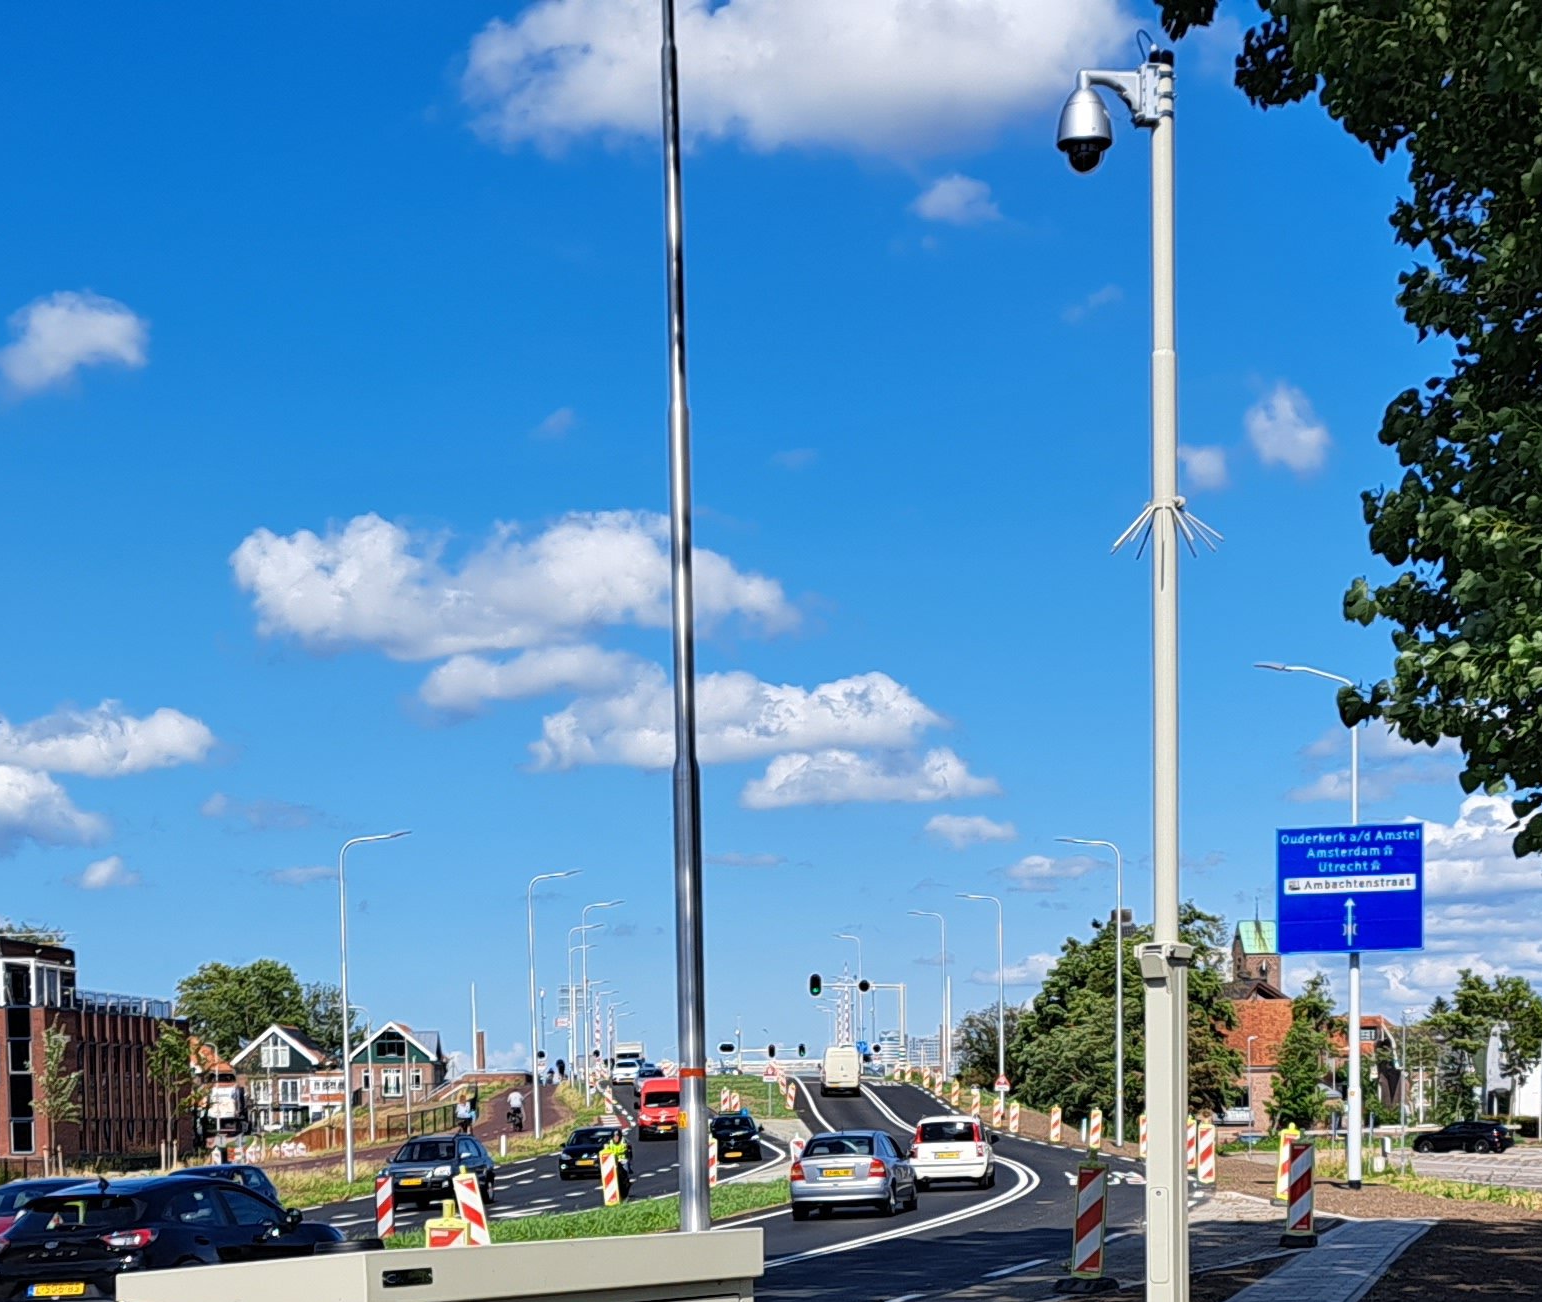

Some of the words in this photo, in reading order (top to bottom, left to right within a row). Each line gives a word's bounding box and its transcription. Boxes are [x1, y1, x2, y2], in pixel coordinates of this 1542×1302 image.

[1281, 832, 1346, 844] Ouderkerk
[1350, 830, 1371, 843] a/d
[1375, 829, 1420, 841] Amstel
[1307, 846, 1380, 858] Amsterdam
[1319, 861, 1368, 872] Utrecht
[1304, 877, 1411, 890] Ambachtenstraat
